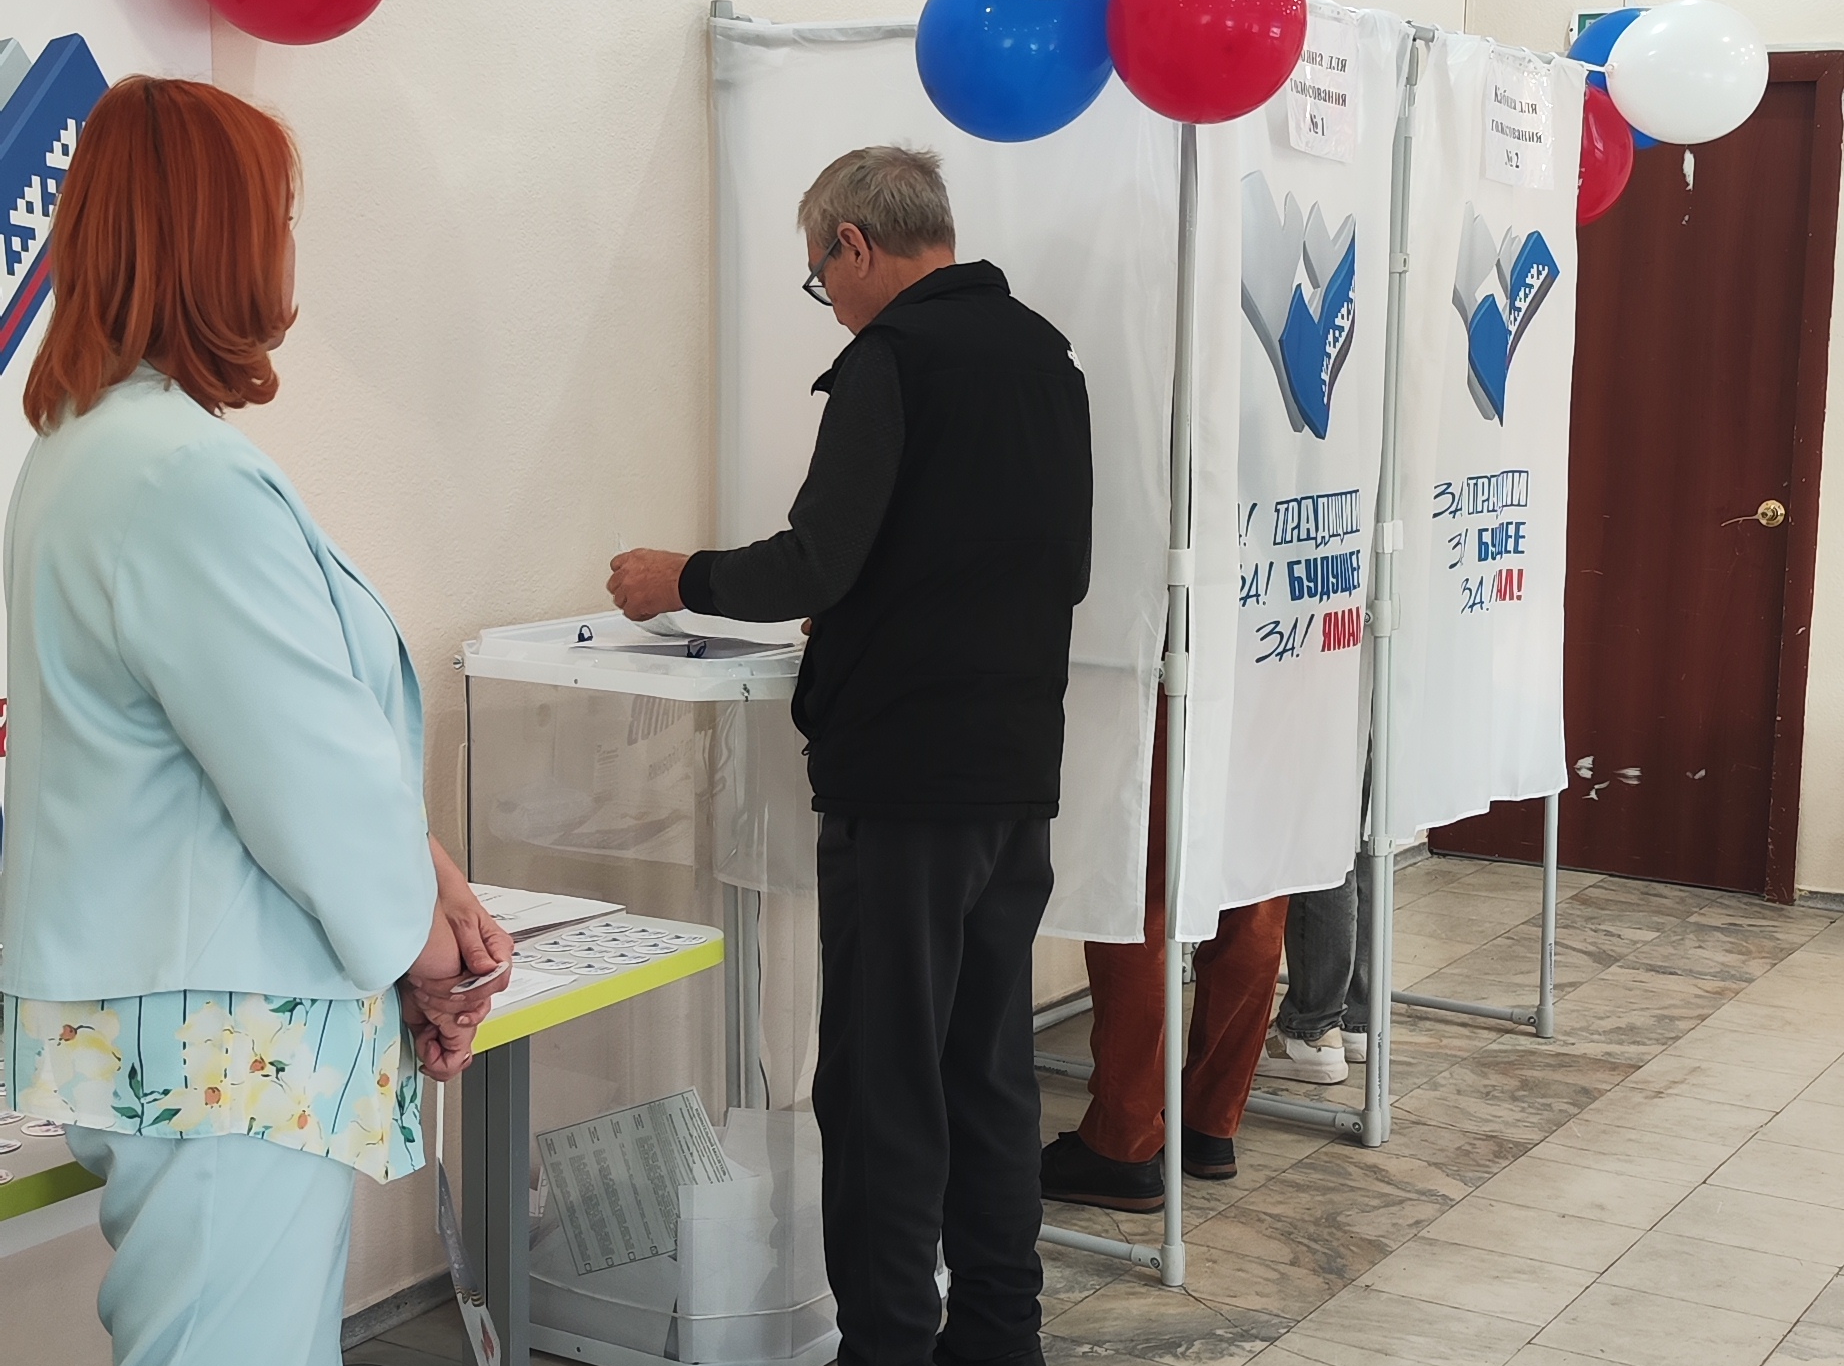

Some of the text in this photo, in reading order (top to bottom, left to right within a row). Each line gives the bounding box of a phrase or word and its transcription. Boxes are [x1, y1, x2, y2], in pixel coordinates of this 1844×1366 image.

[1326, 55, 1347, 73] для
[1290, 78, 1347, 107] голосования
[1519, 101, 1538, 115] для
[1255, 613, 1315, 664] ЗА!
